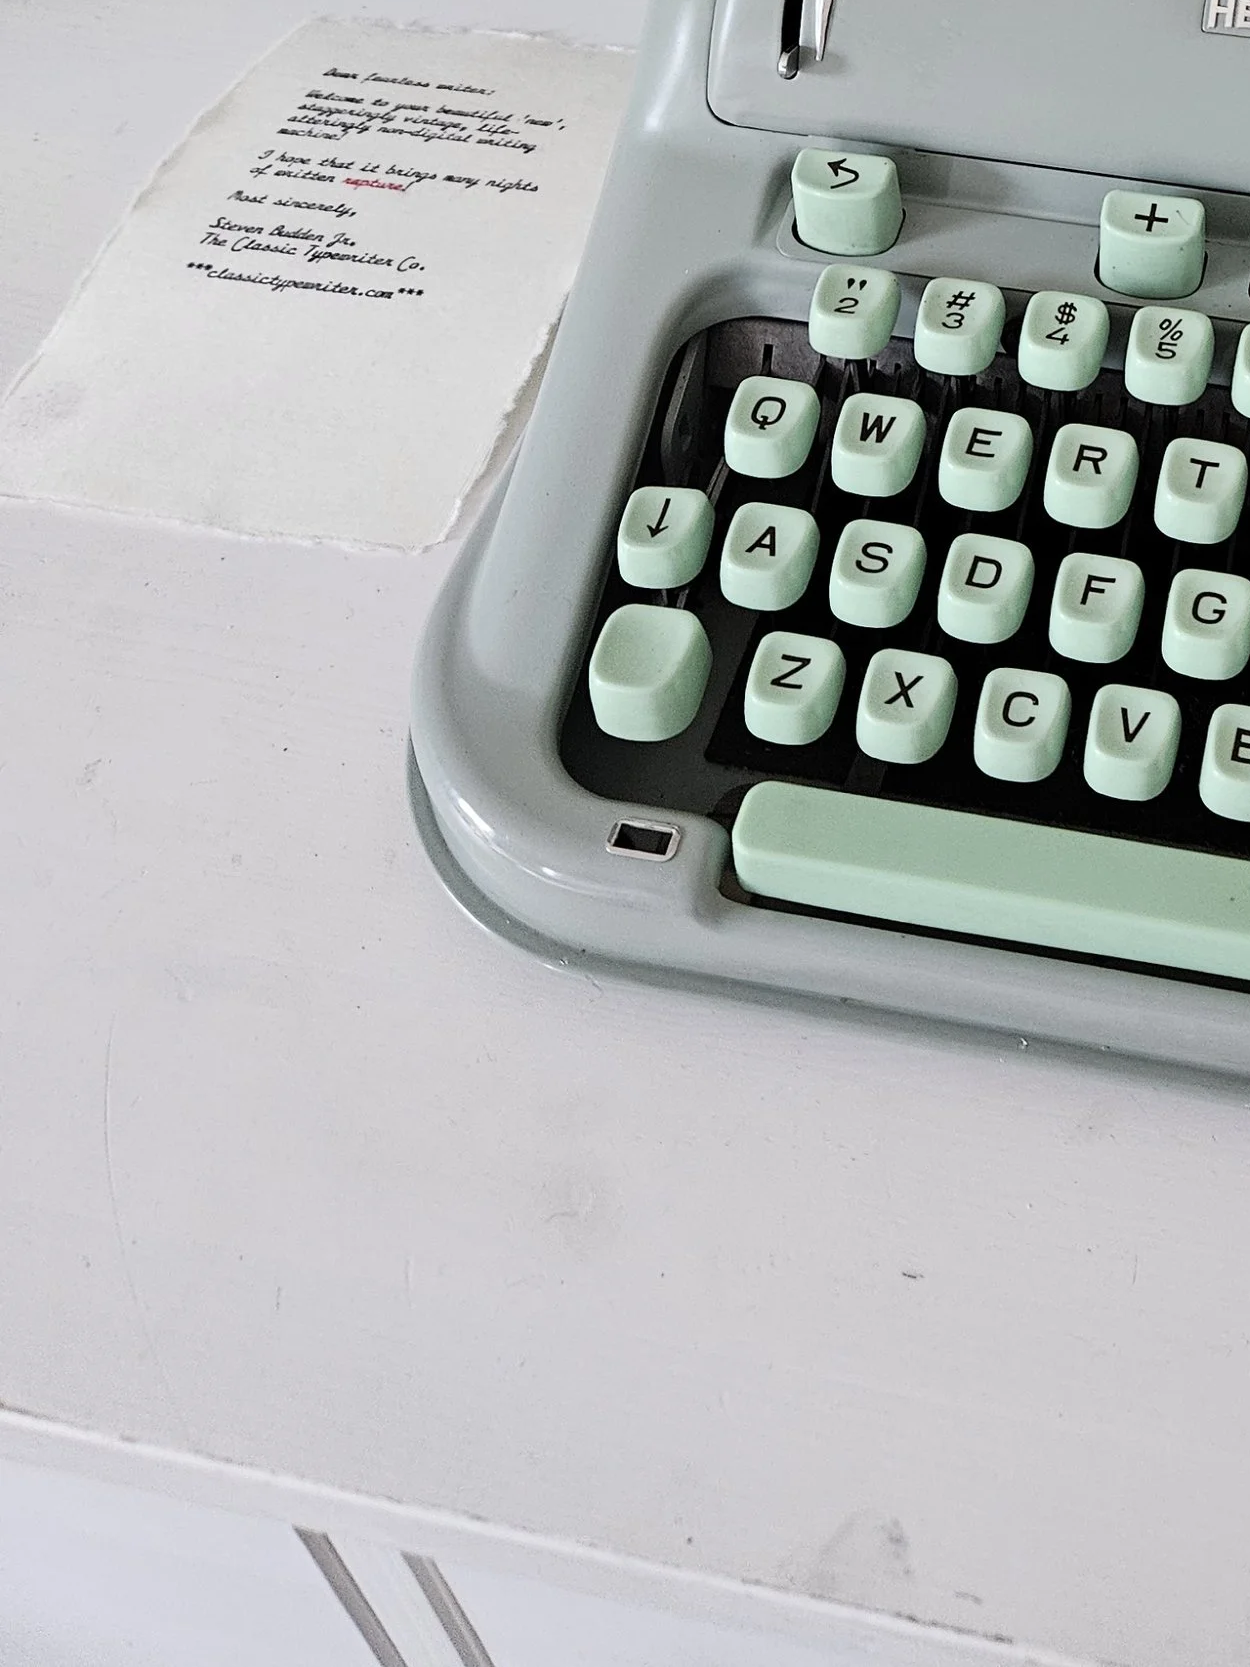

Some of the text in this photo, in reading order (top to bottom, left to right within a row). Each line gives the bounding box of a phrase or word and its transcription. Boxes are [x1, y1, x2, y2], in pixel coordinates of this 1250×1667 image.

[322, 67, 359, 80] Dear
[360, 72, 430, 88] fearless
[305, 89, 364, 104] Welcome
[371, 97, 390, 107] to
[436, 104, 514, 122] beautiful
[476, 137, 537, 154] writing
[249, 164, 273, 178] of
[274, 169, 336, 183] written
[257, 149, 539, 193] I hope that it brings many nights
[227, 189, 357, 219] Most sincerely,
[208, 216, 356, 248] Steven Budden Jr.
[200, 231, 426, 273] The Classic Typewriter Co.
[833, 296, 860, 315] 2
[945, 290, 976, 311] #
[1054, 301, 1078, 326] $
[941, 312, 965, 330] 3
[1045, 326, 1070, 346] 4
[1158, 318, 1184, 342] %
[1154, 341, 1178, 360] 5
[750, 396, 787, 431] Q
[859, 411, 897, 444] W
[964, 426, 1003, 458] E
[1072, 443, 1108, 475] R
[1189, 457, 1220, 489] T
[744, 525, 776, 557] A
[854, 541, 894, 574] S
[964, 554, 1003, 589] D
[1079, 574, 1117, 606] F
[1191, 591, 1228, 625] G
[769, 653, 812, 690] Z
[883, 671, 924, 709] X
[1001, 691, 1039, 728] C
[1120, 706, 1151, 744] V
